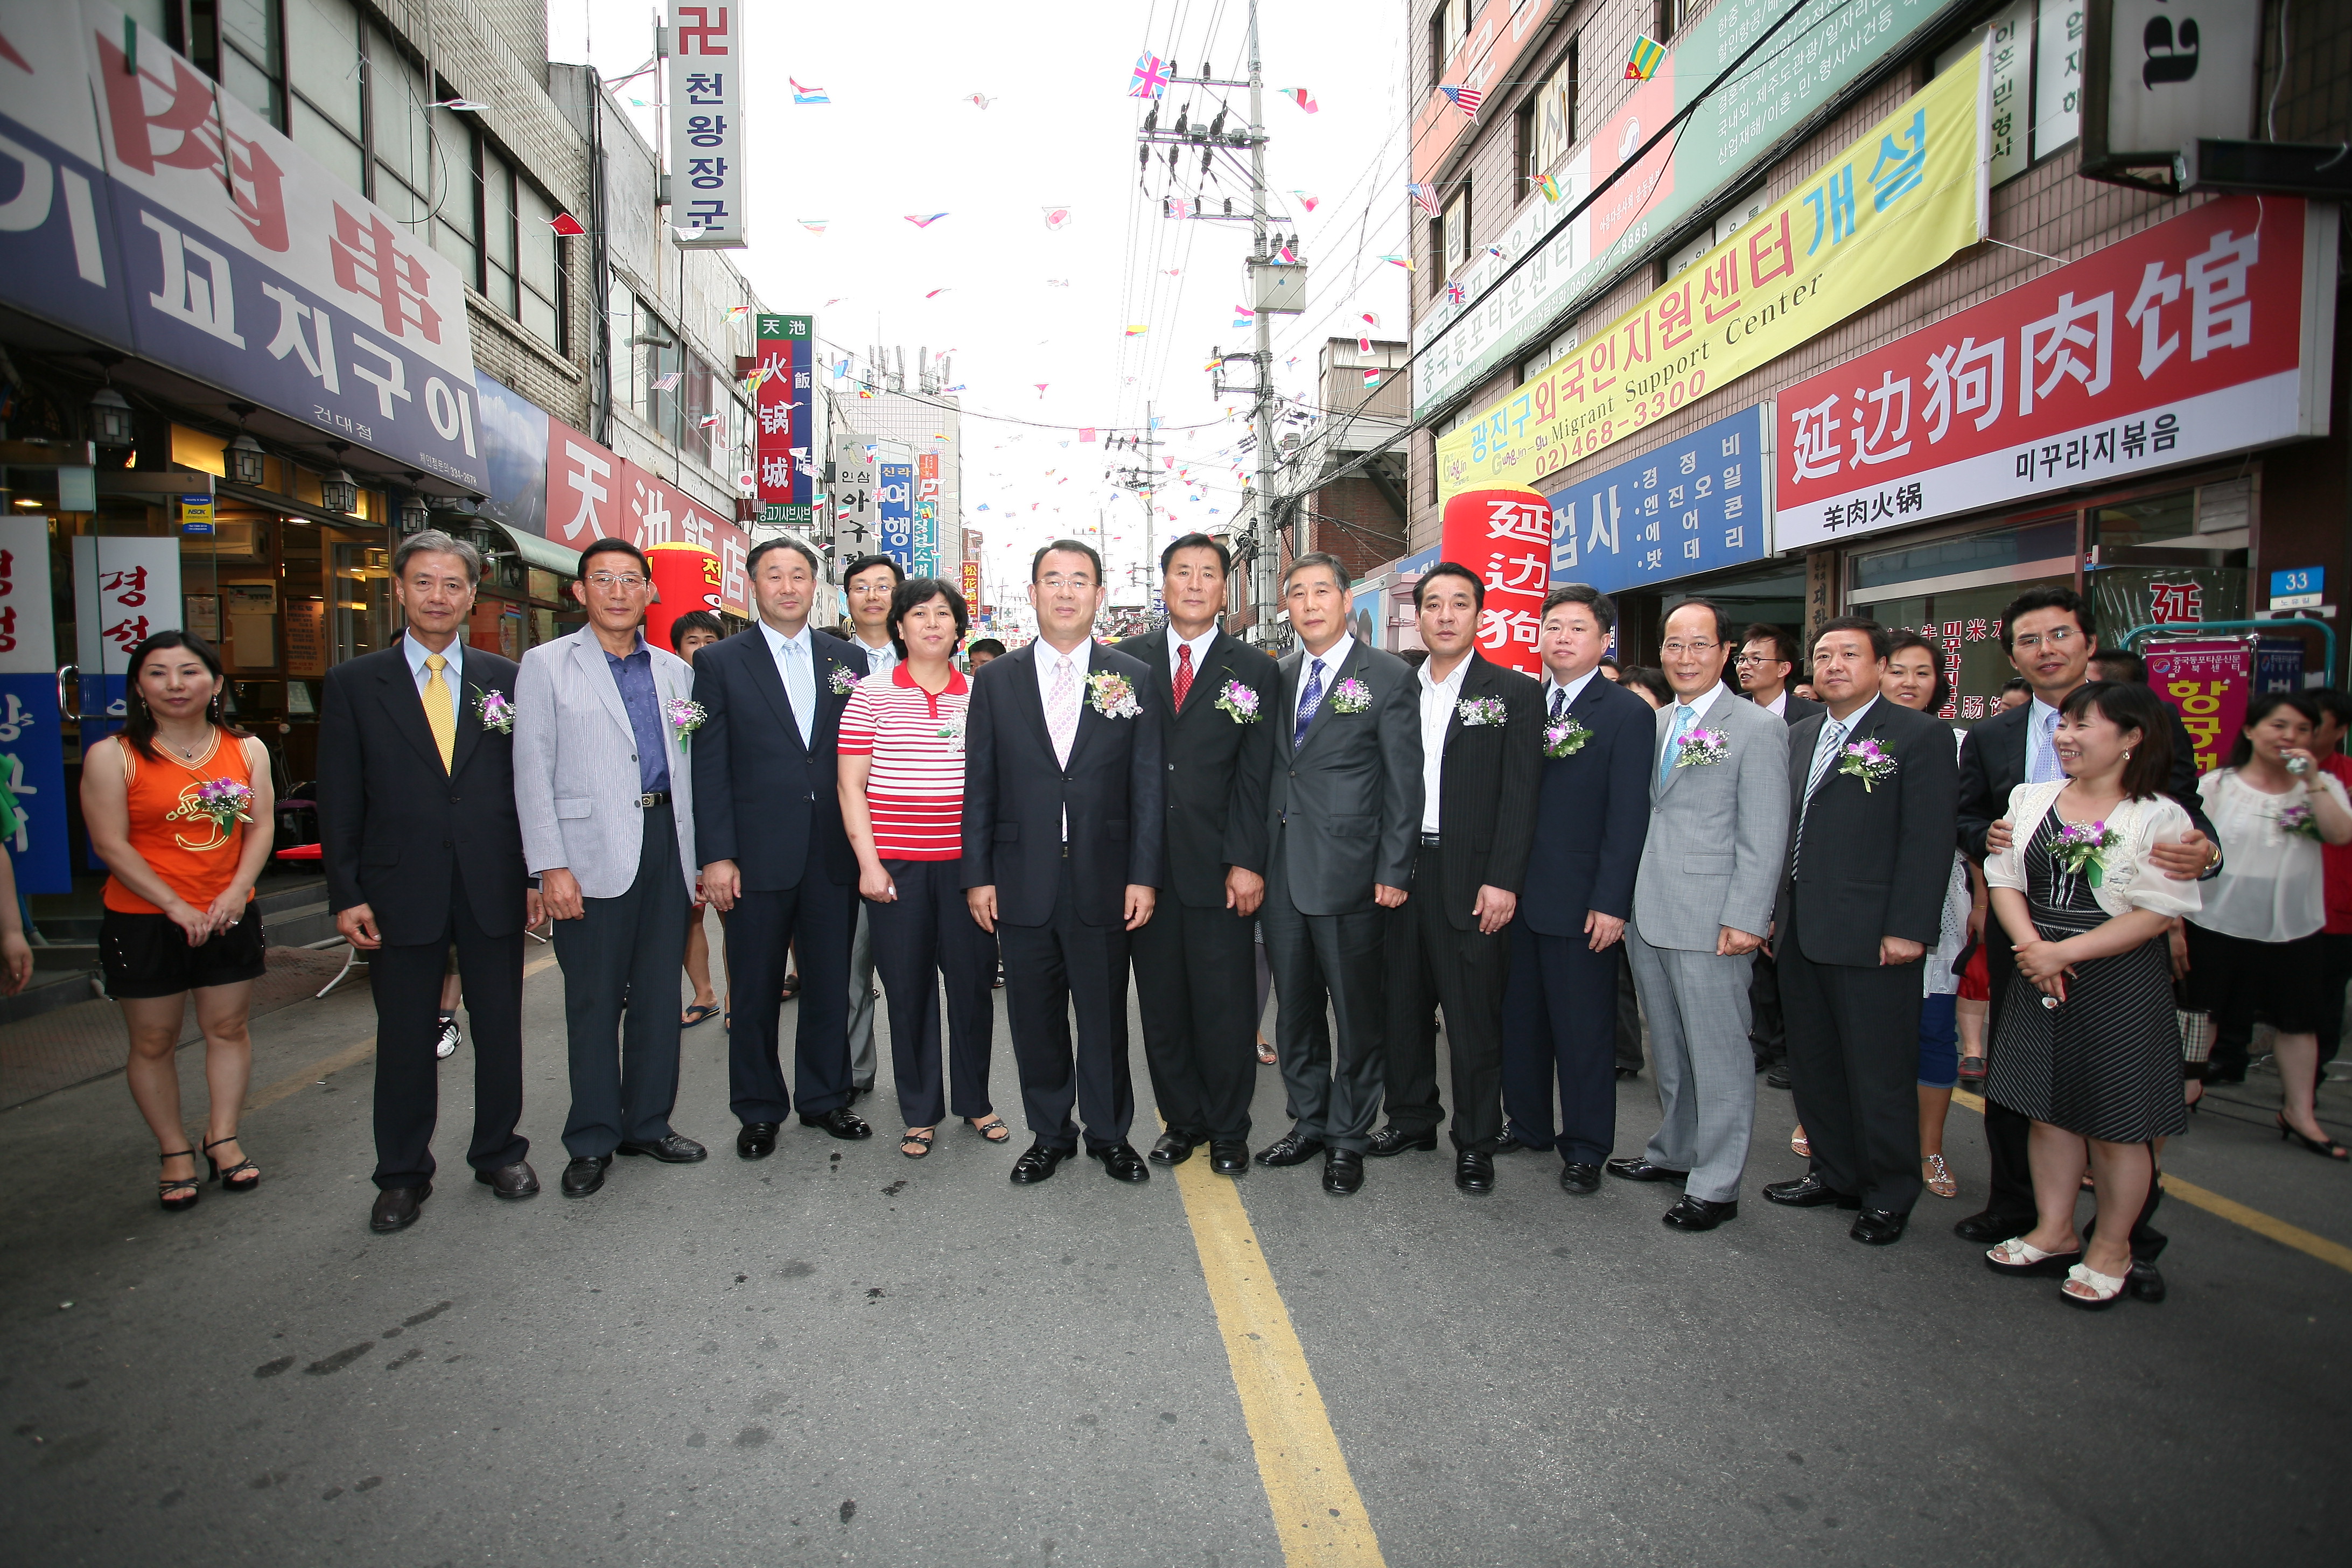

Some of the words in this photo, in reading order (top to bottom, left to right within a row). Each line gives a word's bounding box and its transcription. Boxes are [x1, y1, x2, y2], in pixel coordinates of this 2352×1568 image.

[686, 73, 729, 230] 천왕장군
[0, 30, 443, 345] 肉串
[1599, 192, 1633, 234] 아름다운사회
[1423, 223, 1573, 394] 중국동포타운센터
[1471, 393, 1531, 464] 광진구
[1535, 209, 1795, 426] 외국인지원센터
[1802, 107, 1926, 256] 개설
[763, 319, 806, 335] 天池
[1551, 402, 1614, 445] Migrant
[1625, 340, 1709, 404] Support
[1725, 272, 1822, 345] Center
[1791, 229, 2261, 484] 延边狗肉馆
[314, 405, 372, 441] 건대점
[759, 352, 789, 488] 火锅城
[1535, 371, 1706, 477] 02)468-3300
[2017, 413, 2180, 482] 미꾸라지볶음
[842, 471, 870, 483] 인삼
[882, 467, 911, 477] 신라
[1823, 482, 1923, 531] 羊肉火锅
[884, 481, 911, 574] 여행사
[2150, 583, 2202, 634] 延
[2286, 572, 2308, 590] 33
[2172, 655, 2241, 665] 중국동포타운신문
